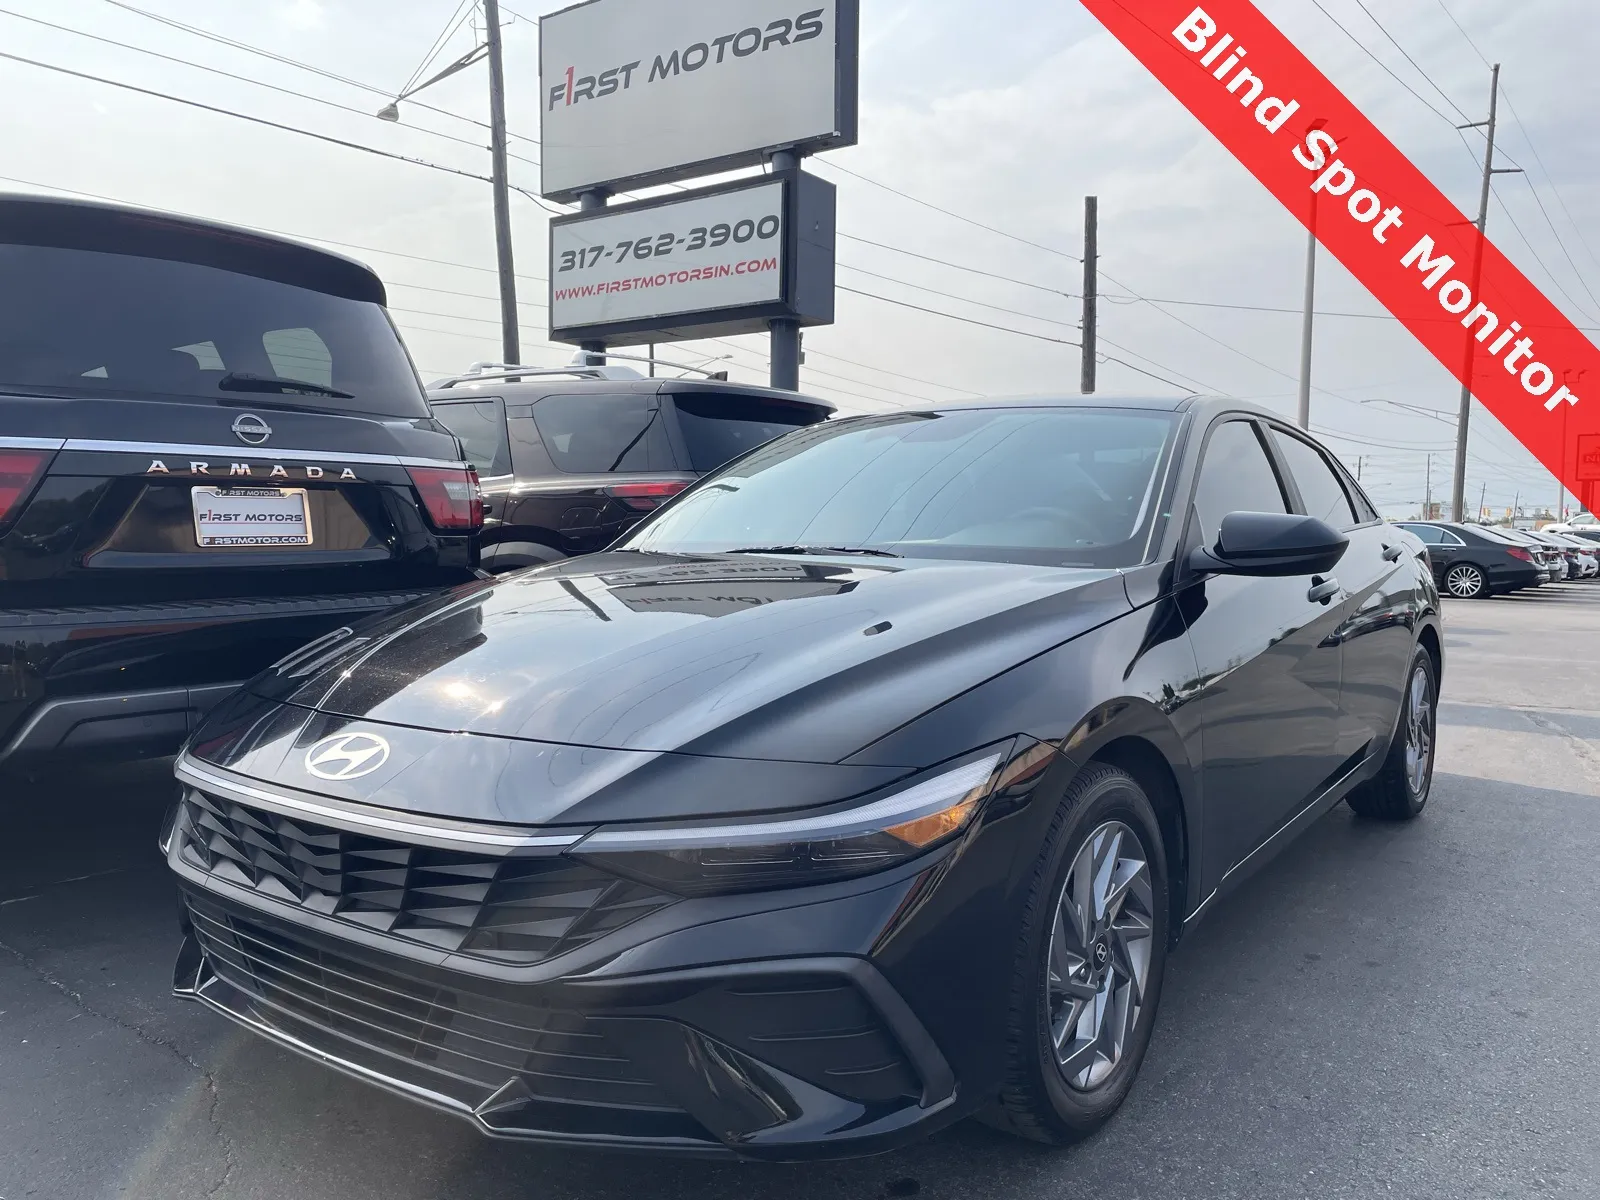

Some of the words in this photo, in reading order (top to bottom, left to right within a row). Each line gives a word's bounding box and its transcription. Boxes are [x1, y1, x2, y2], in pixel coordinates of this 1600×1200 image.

[648, 8, 825, 83] MOTORS
[558, 214, 780, 272] 317-762-3900
[555, 257, 777, 301] WWW.FIRSTMOTORSIN.COM
[147, 460, 357, 480] ARMADA
[245, 513, 303, 522] MOTORS
[203, 536, 307, 545] FRSTMOTOR.COM
